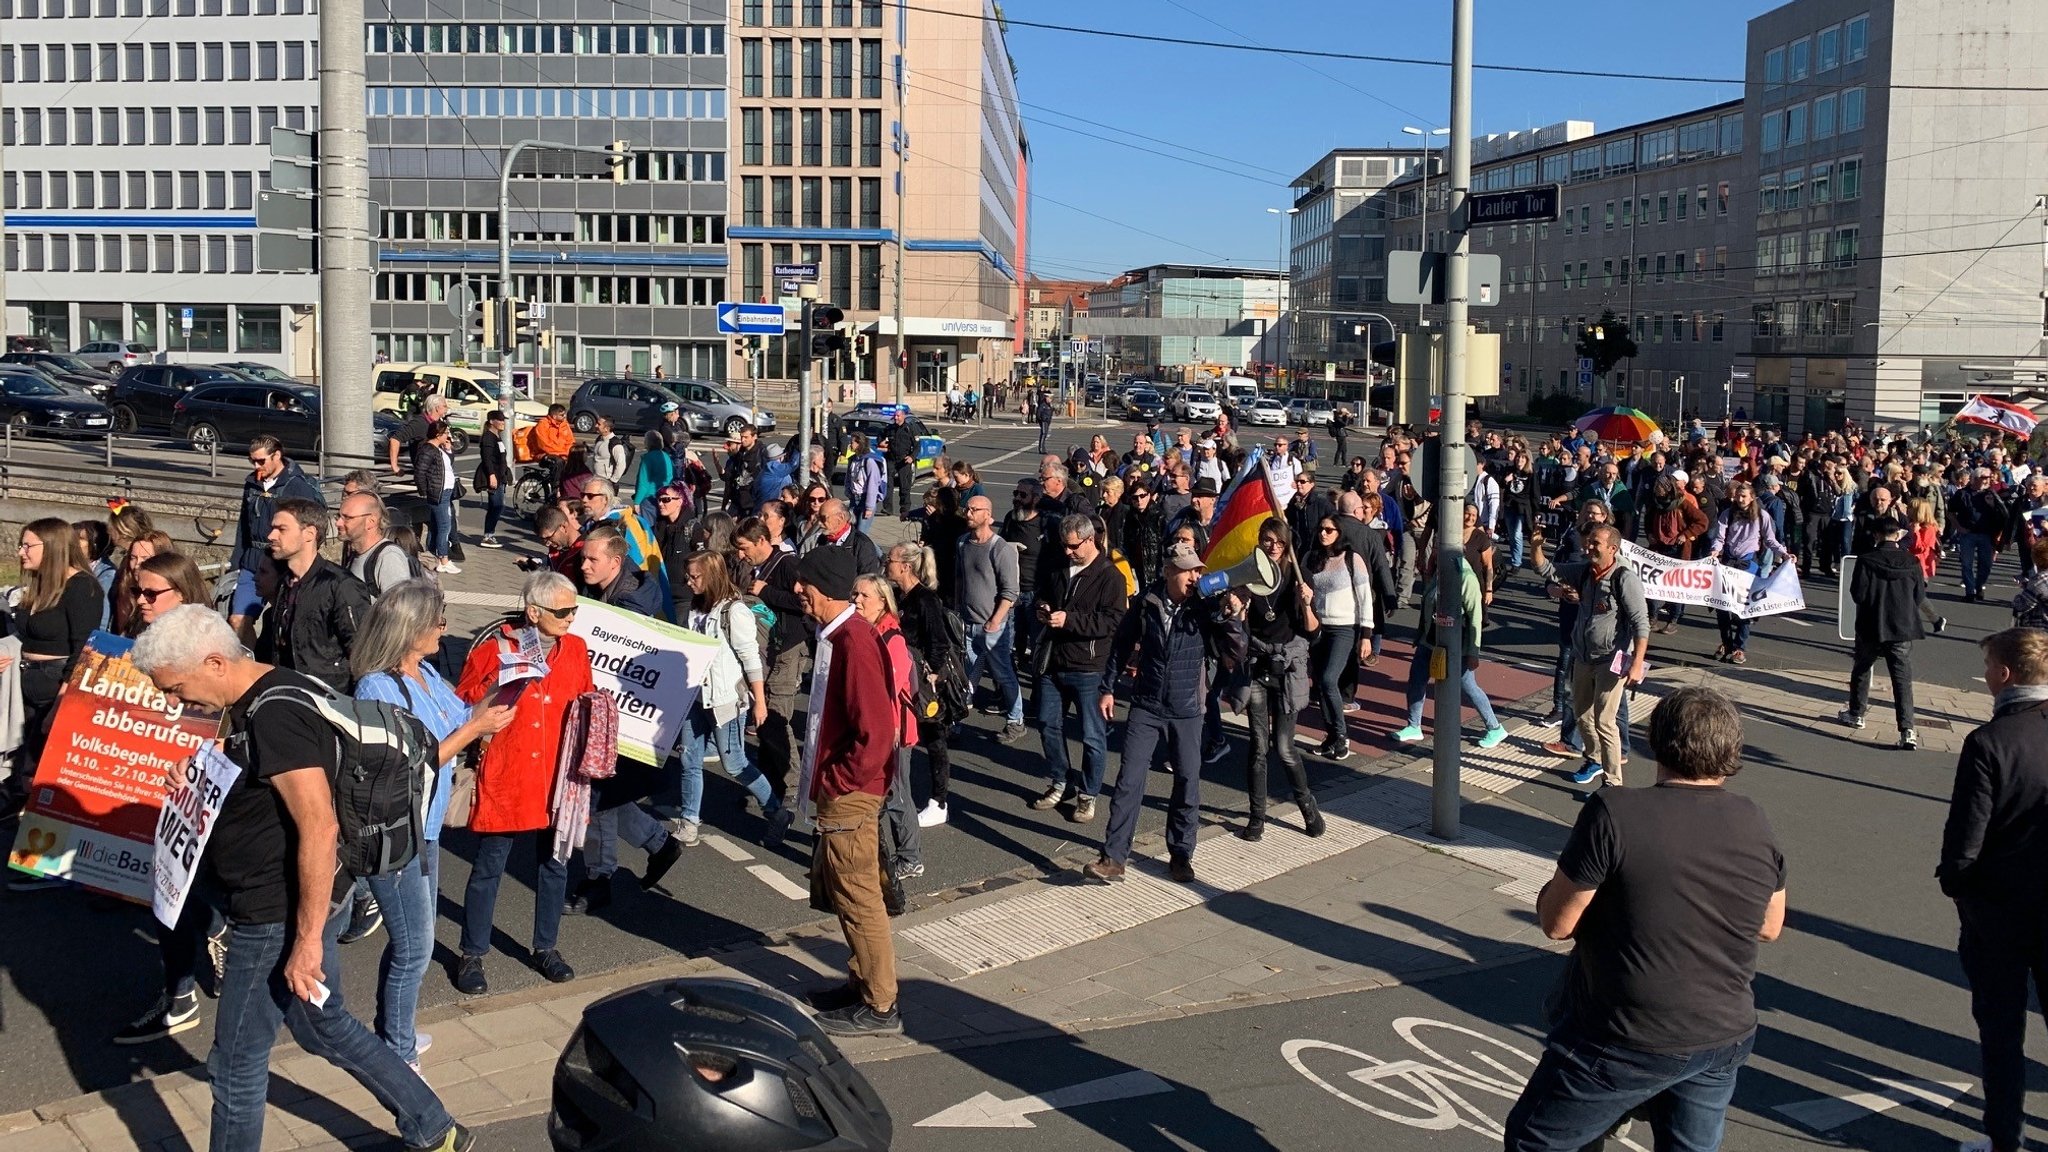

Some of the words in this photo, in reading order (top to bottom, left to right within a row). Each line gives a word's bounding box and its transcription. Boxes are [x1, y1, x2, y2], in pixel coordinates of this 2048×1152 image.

[1477, 198, 1518, 217] Laufer
[1525, 194, 1546, 213] Tor
[737, 314, 780, 324] Einbahnstraße
[1075, 341, 1082, 351] U
[1663, 568, 1713, 590] MUSS
[1763, 599, 1783, 611] Liste
[591, 626, 660, 656] Bayerischen
[587, 649, 662, 690] andtag
[92, 707, 203, 750] abberufen
[65, 752, 100, 771] 14.10.
[71, 732, 173, 771] Volksbegehre
[57, 777, 74, 786] oder
[74, 780, 140, 804] Gemeindebehörde
[60, 766, 113, 787] Unterschreiben
[113, 781, 125, 791] Sie
[126, 783, 134, 792] in
[134, 786, 152, 797] Ihrer
[154, 790, 166, 801] Sta
[158, 805, 199, 873] WEG
[92, 846, 151, 875] dieBas
